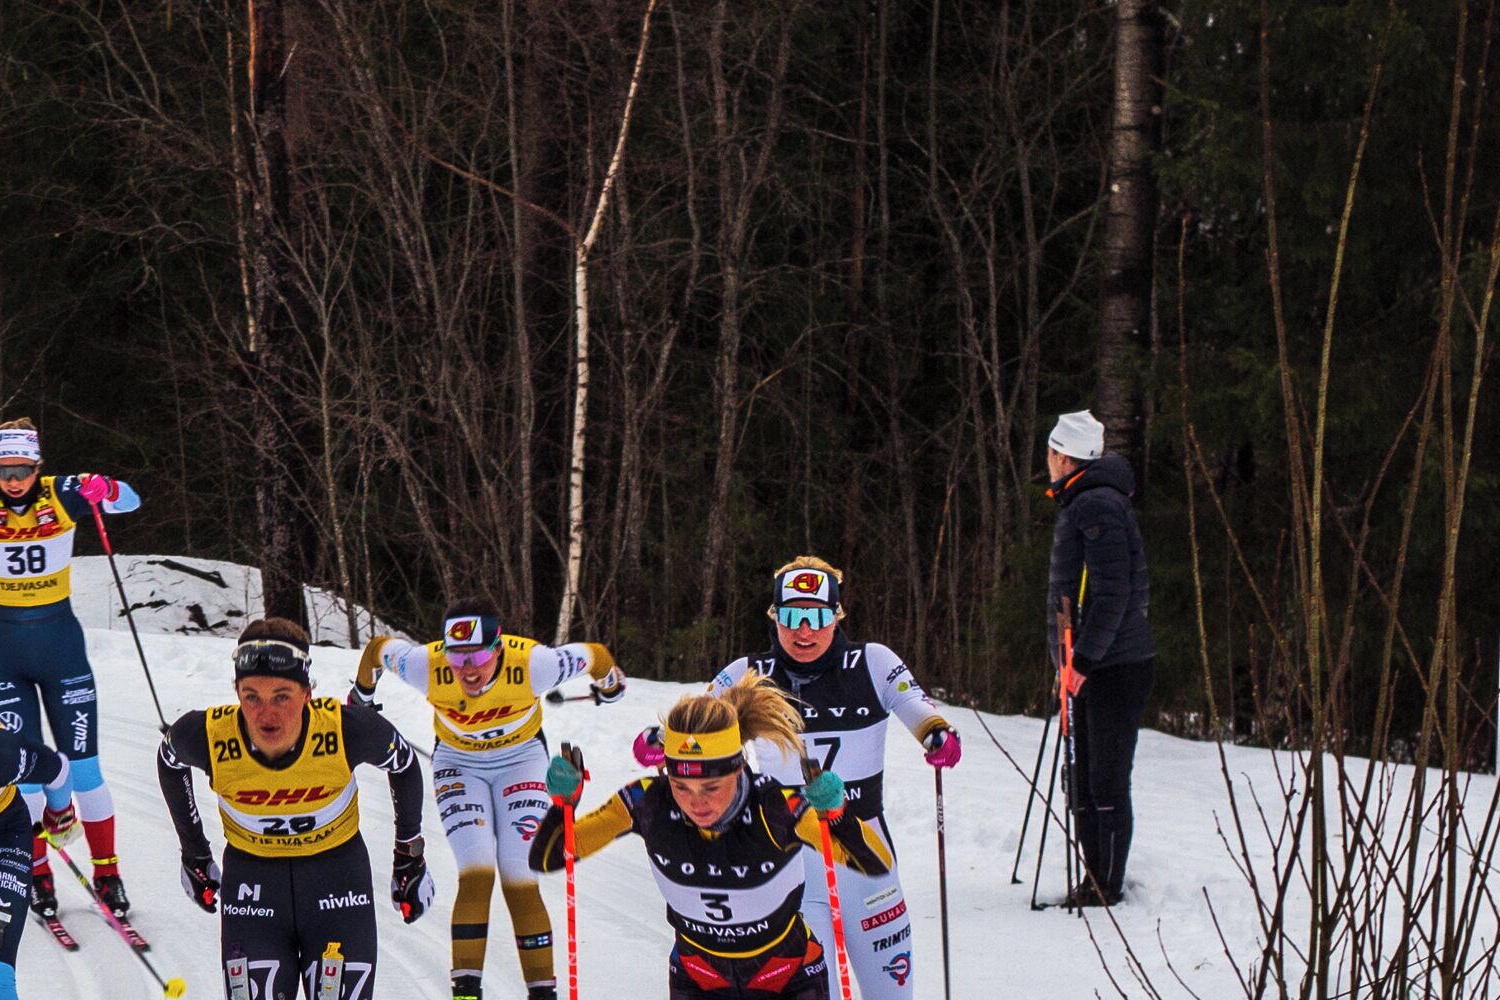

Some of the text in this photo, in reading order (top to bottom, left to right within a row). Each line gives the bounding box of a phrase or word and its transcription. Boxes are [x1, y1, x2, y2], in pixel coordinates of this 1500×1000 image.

[4, 544, 46, 575] 38
[0, 578, 58, 591] TJEJVASAN
[756, 659, 776, 677] 17
[843, 650, 862, 669] 17
[434, 666, 454, 686] 10
[506, 666, 524, 685] 10
[446, 705, 513, 725] DHL
[214, 737, 242, 763] 28
[311, 731, 339, 757] 28
[813, 736, 841, 772] 7
[235, 786, 330, 806] DHL
[654, 853, 775, 878] VOLVO
[223, 904, 275, 918] Moelven
[700, 892, 733, 922] 3
[682, 919, 769, 936] TJEJVASAN
